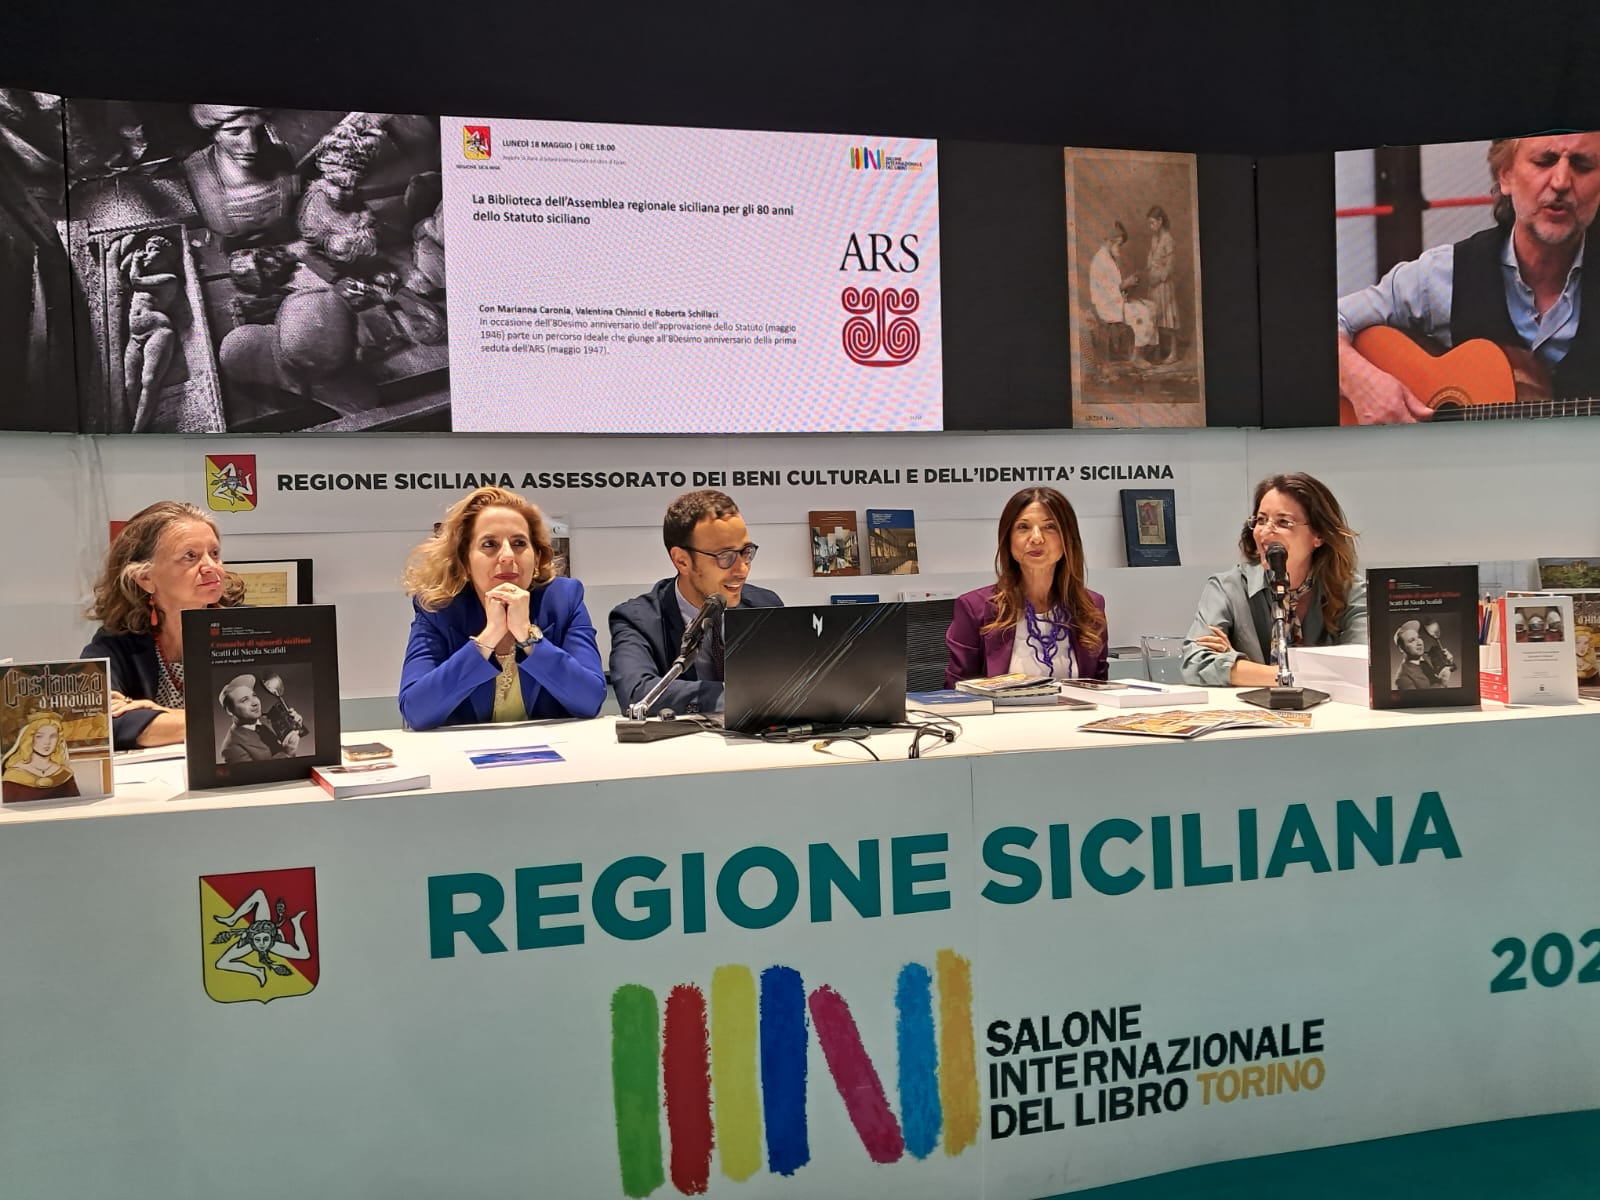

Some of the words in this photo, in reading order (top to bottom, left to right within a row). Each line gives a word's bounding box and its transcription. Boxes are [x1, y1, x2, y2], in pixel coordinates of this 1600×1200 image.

[502, 138, 529, 148] LUNEDÌ
[531, 141, 540, 149] 18
[541, 141, 573, 150] MAGGIO
[580, 143, 595, 151] ORE
[596, 144, 616, 152] 18:00
[472, 194, 485, 205] La
[487, 194, 542, 207] Biblioteca
[627, 200, 676, 213] regionale
[679, 200, 720, 214] siciliana
[722, 204, 740, 217] per
[742, 203, 755, 217] gli
[756, 204, 770, 216] 80
[772, 205, 794, 216] anni
[472, 210, 501, 222] dello
[503, 211, 544, 223] Statuto
[546, 213, 591, 225] siciliano
[838, 231, 920, 273] ARS
[479, 304, 495, 313] Con
[497, 305, 537, 314] Marianna
[575, 307, 613, 316] Valentina
[615, 308, 647, 317] Chinnici
[655, 309, 686, 318] Roberta
[688, 310, 719, 319] Schillaci
[479, 318, 488, 326] In
[490, 319, 533, 327] occasione
[590, 320, 640, 330] anniversario
[713, 323, 734, 332] dello
[735, 323, 763, 332] Statuto
[765, 323, 797, 334] (maggio
[480, 330, 506, 341] 1946)
[507, 332, 530, 341] parte
[532, 333, 543, 341] un
[545, 333, 582, 343] percorso
[583, 332, 609, 342] ideale
[610, 333, 626, 342] che
[627, 334, 655, 345] giunge
[703, 335, 752, 344] anniversario
[753, 336, 773, 345] della
[774, 337, 797, 346] prima
[480, 344, 510, 353] seduta
[547, 345, 581, 355] (maggio
[277, 473, 388, 491] REGIONE
[394, 472, 515, 490] SICILIANA
[521, 471, 687, 489] ASSESSORATO
[692, 471, 727, 487] DEI
[732, 470, 781, 486] BENI
[786, 468, 900, 486] CULTURALI
[907, 468, 918, 484] E
[1079, 464, 1175, 481] SICILIANA
[210, 648, 232, 658] Scatti
[232, 647, 240, 657] di
[240, 647, 262, 657] Nicola
[263, 645, 287, 656] Scafidi
[4, 664, 104, 708] Costanza
[427, 832, 952, 960] REGIONE
[980, 791, 1463, 905] SICILIANA
[986, 1004, 1142, 1057] SALONE
[989, 1018, 1326, 1100] INTERNAZIONALE
[990, 1096, 1065, 1140] DEL
[1075, 1077, 1189, 1127] LIBRO
[1196, 1057, 1326, 1106] TORINO
